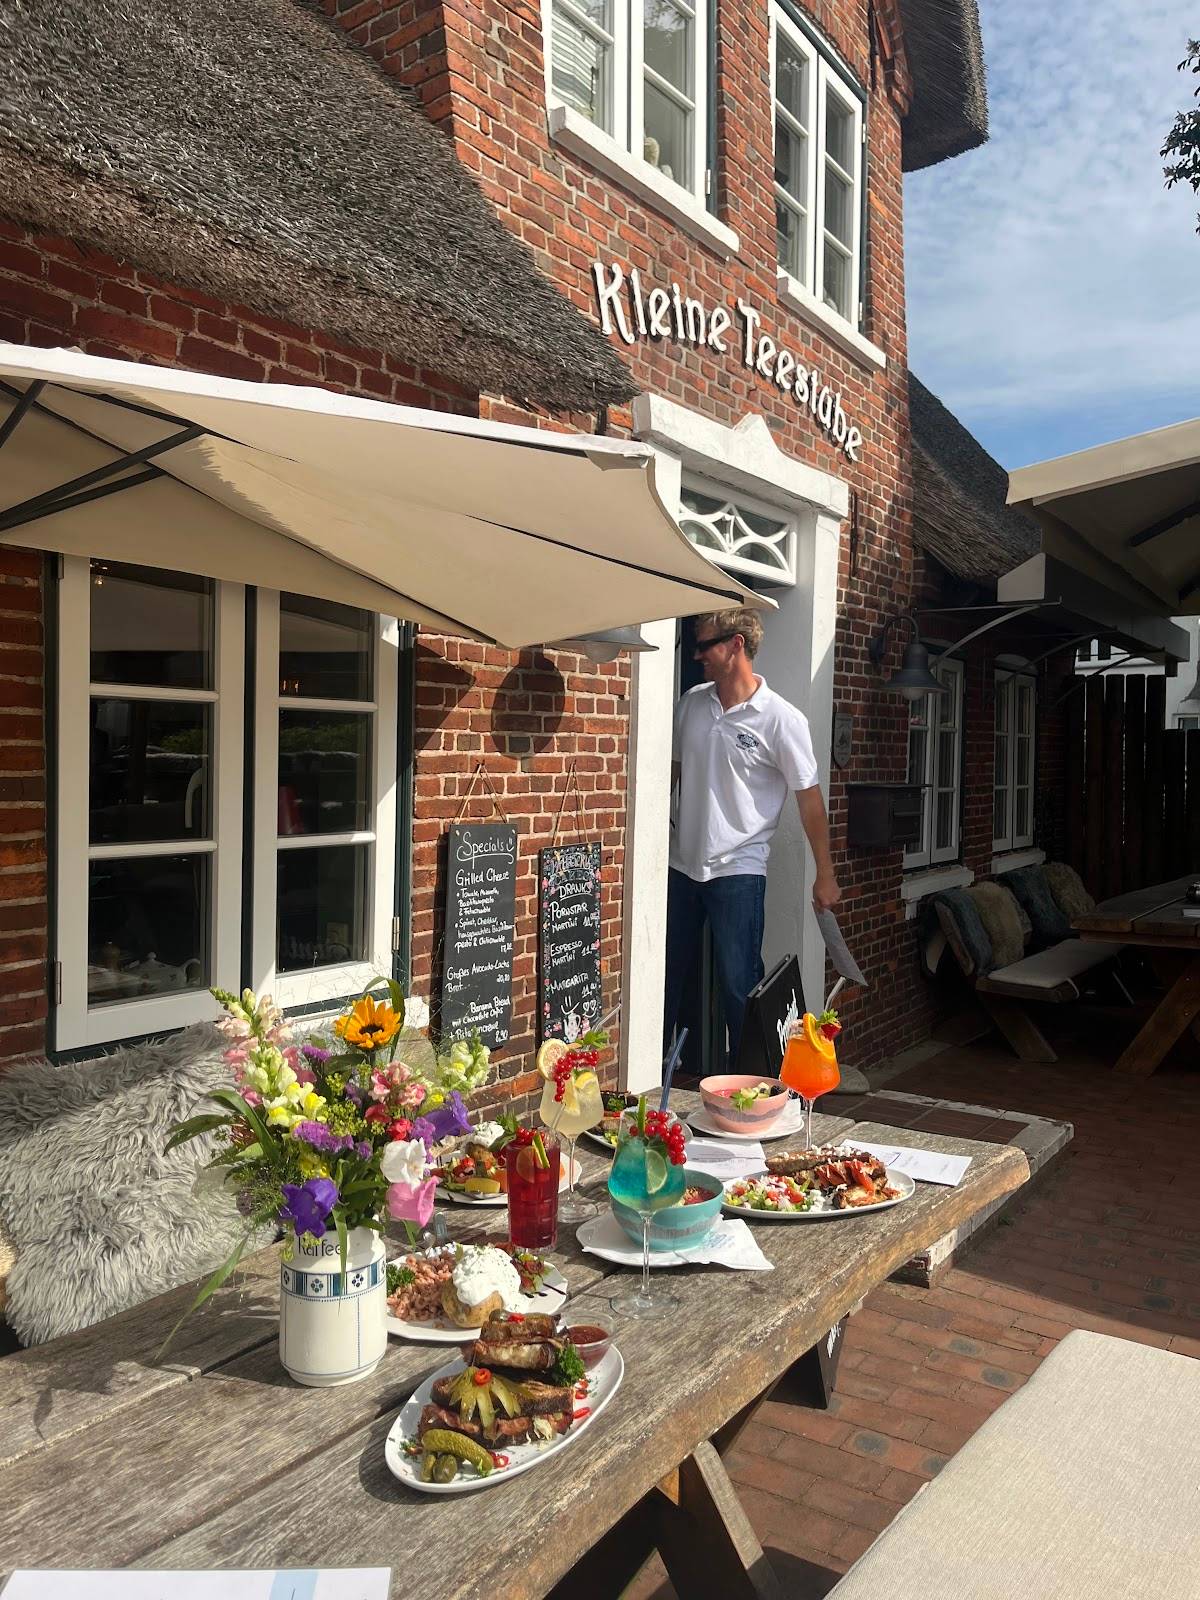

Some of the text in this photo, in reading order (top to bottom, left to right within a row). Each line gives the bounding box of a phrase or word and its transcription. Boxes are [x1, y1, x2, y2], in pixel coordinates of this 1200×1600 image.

[593, 262, 862, 462] Kleine Teestube
[457, 831, 504, 866] Specials
[456, 867, 510, 886] Grilled Cheese
[550, 940, 583, 957] ESPRESSO
[446, 966, 470, 981] Großes
[469, 996, 511, 1014] Banana Bread
[451, 1018, 461, 1027] mit
[462, 1011, 490, 1024] Chocolate
